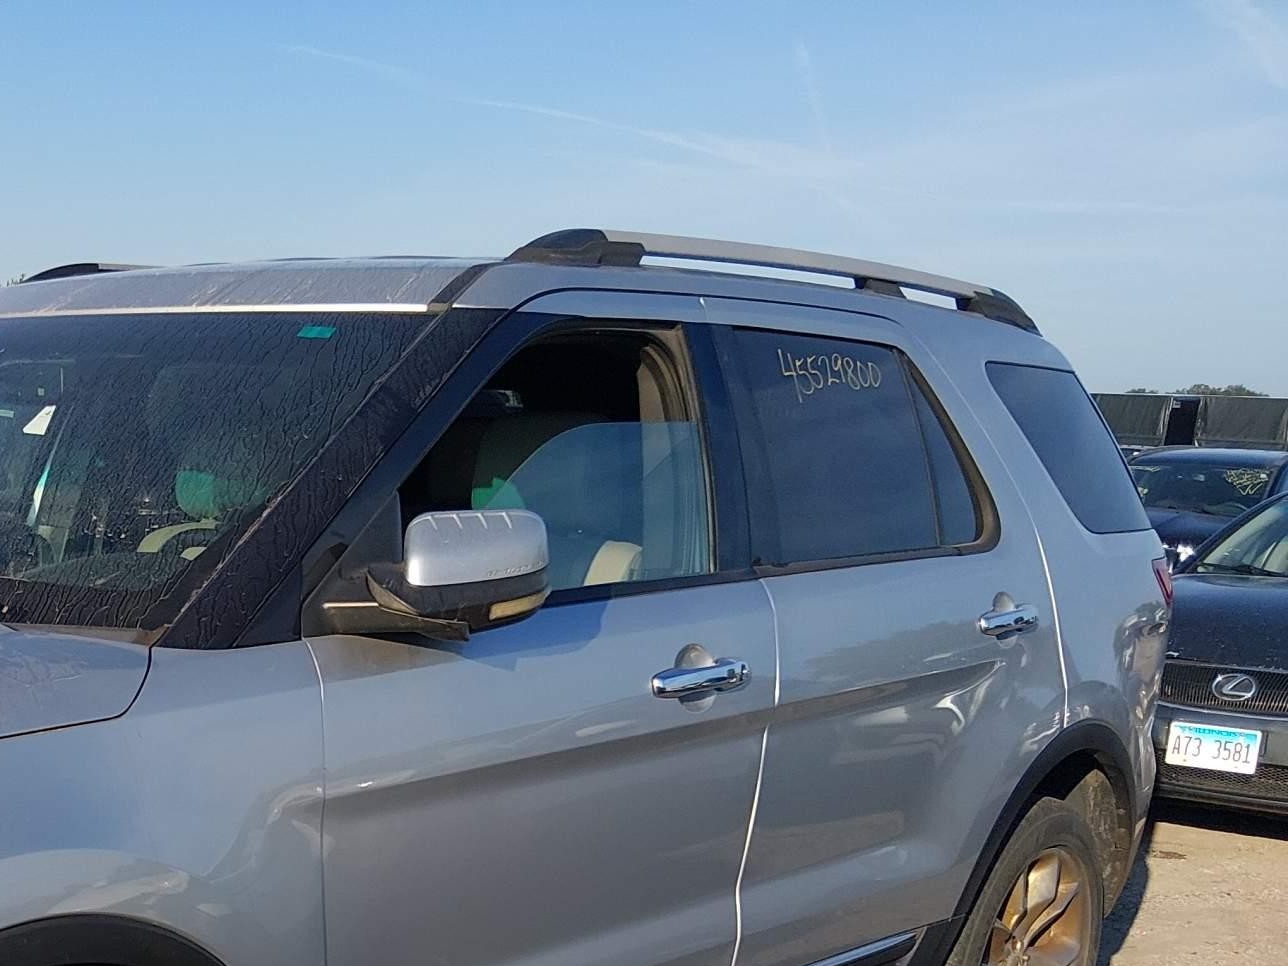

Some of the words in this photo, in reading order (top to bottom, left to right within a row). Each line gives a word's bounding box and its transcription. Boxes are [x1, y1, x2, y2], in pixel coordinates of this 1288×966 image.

[777, 348, 882, 403] 45529800
[1172, 735, 1202, 757] A73
[1212, 740, 1251, 764] 3581
